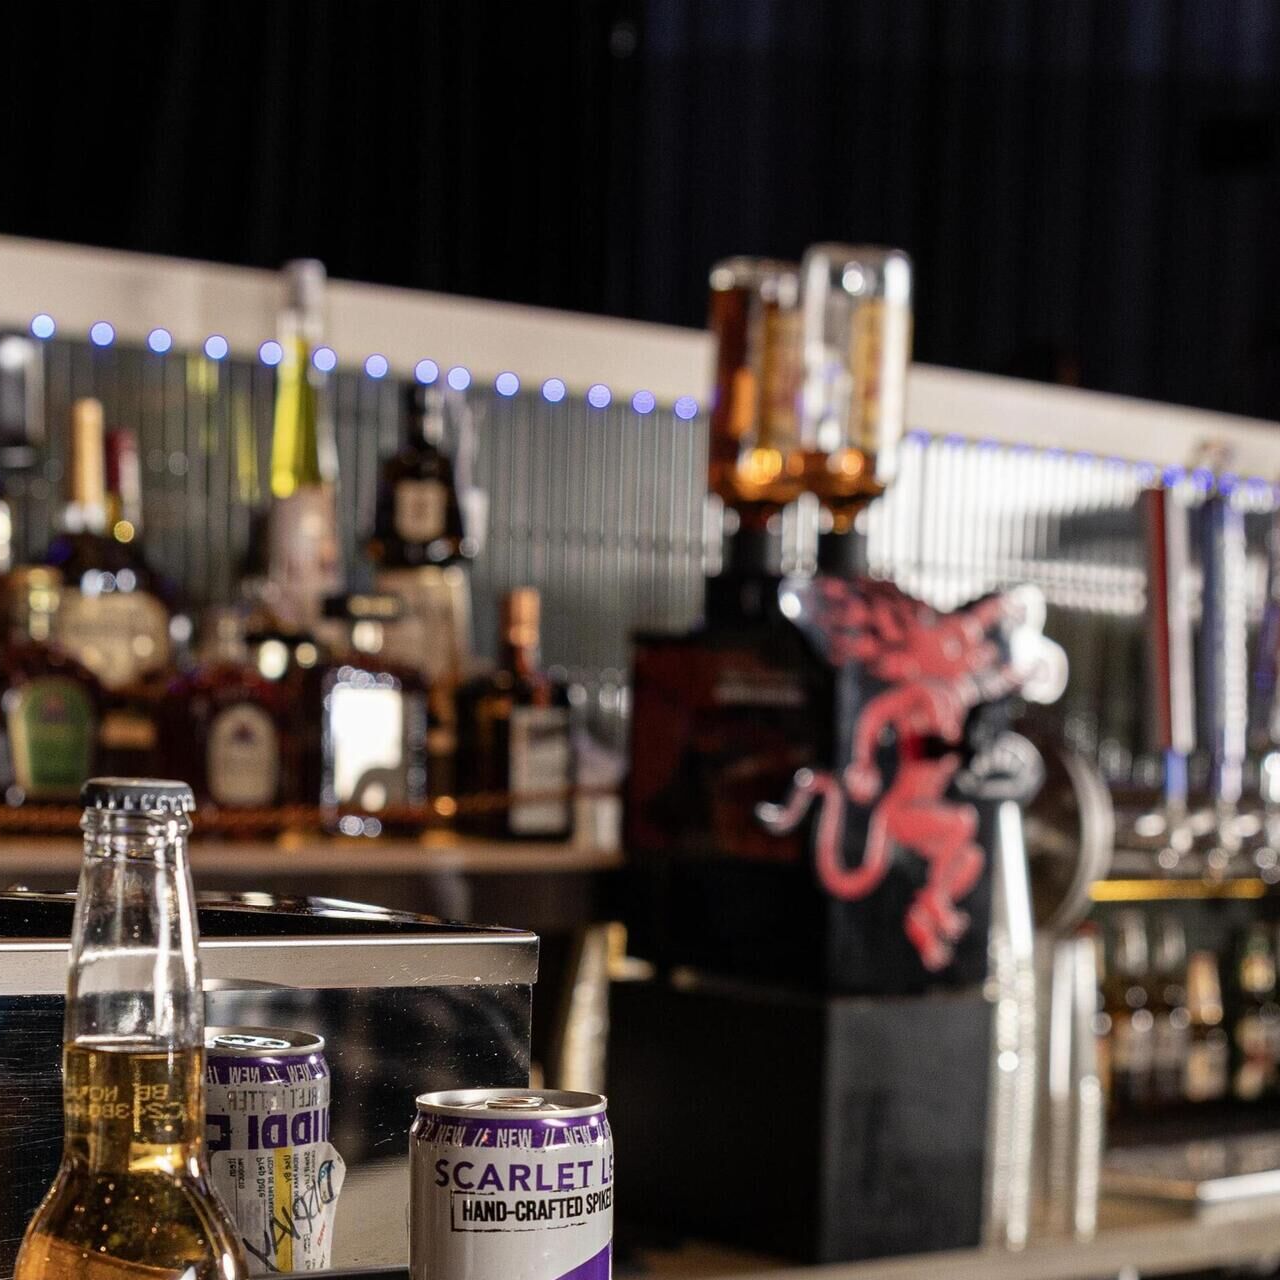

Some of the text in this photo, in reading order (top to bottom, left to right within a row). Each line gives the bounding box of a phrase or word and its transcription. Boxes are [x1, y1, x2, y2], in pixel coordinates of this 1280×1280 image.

[436, 1124, 593, 1148] NEW NEW NEW
[434, 1158, 593, 1192] SCARLET
[462, 1195, 583, 1222] HAND-CRAFTED
